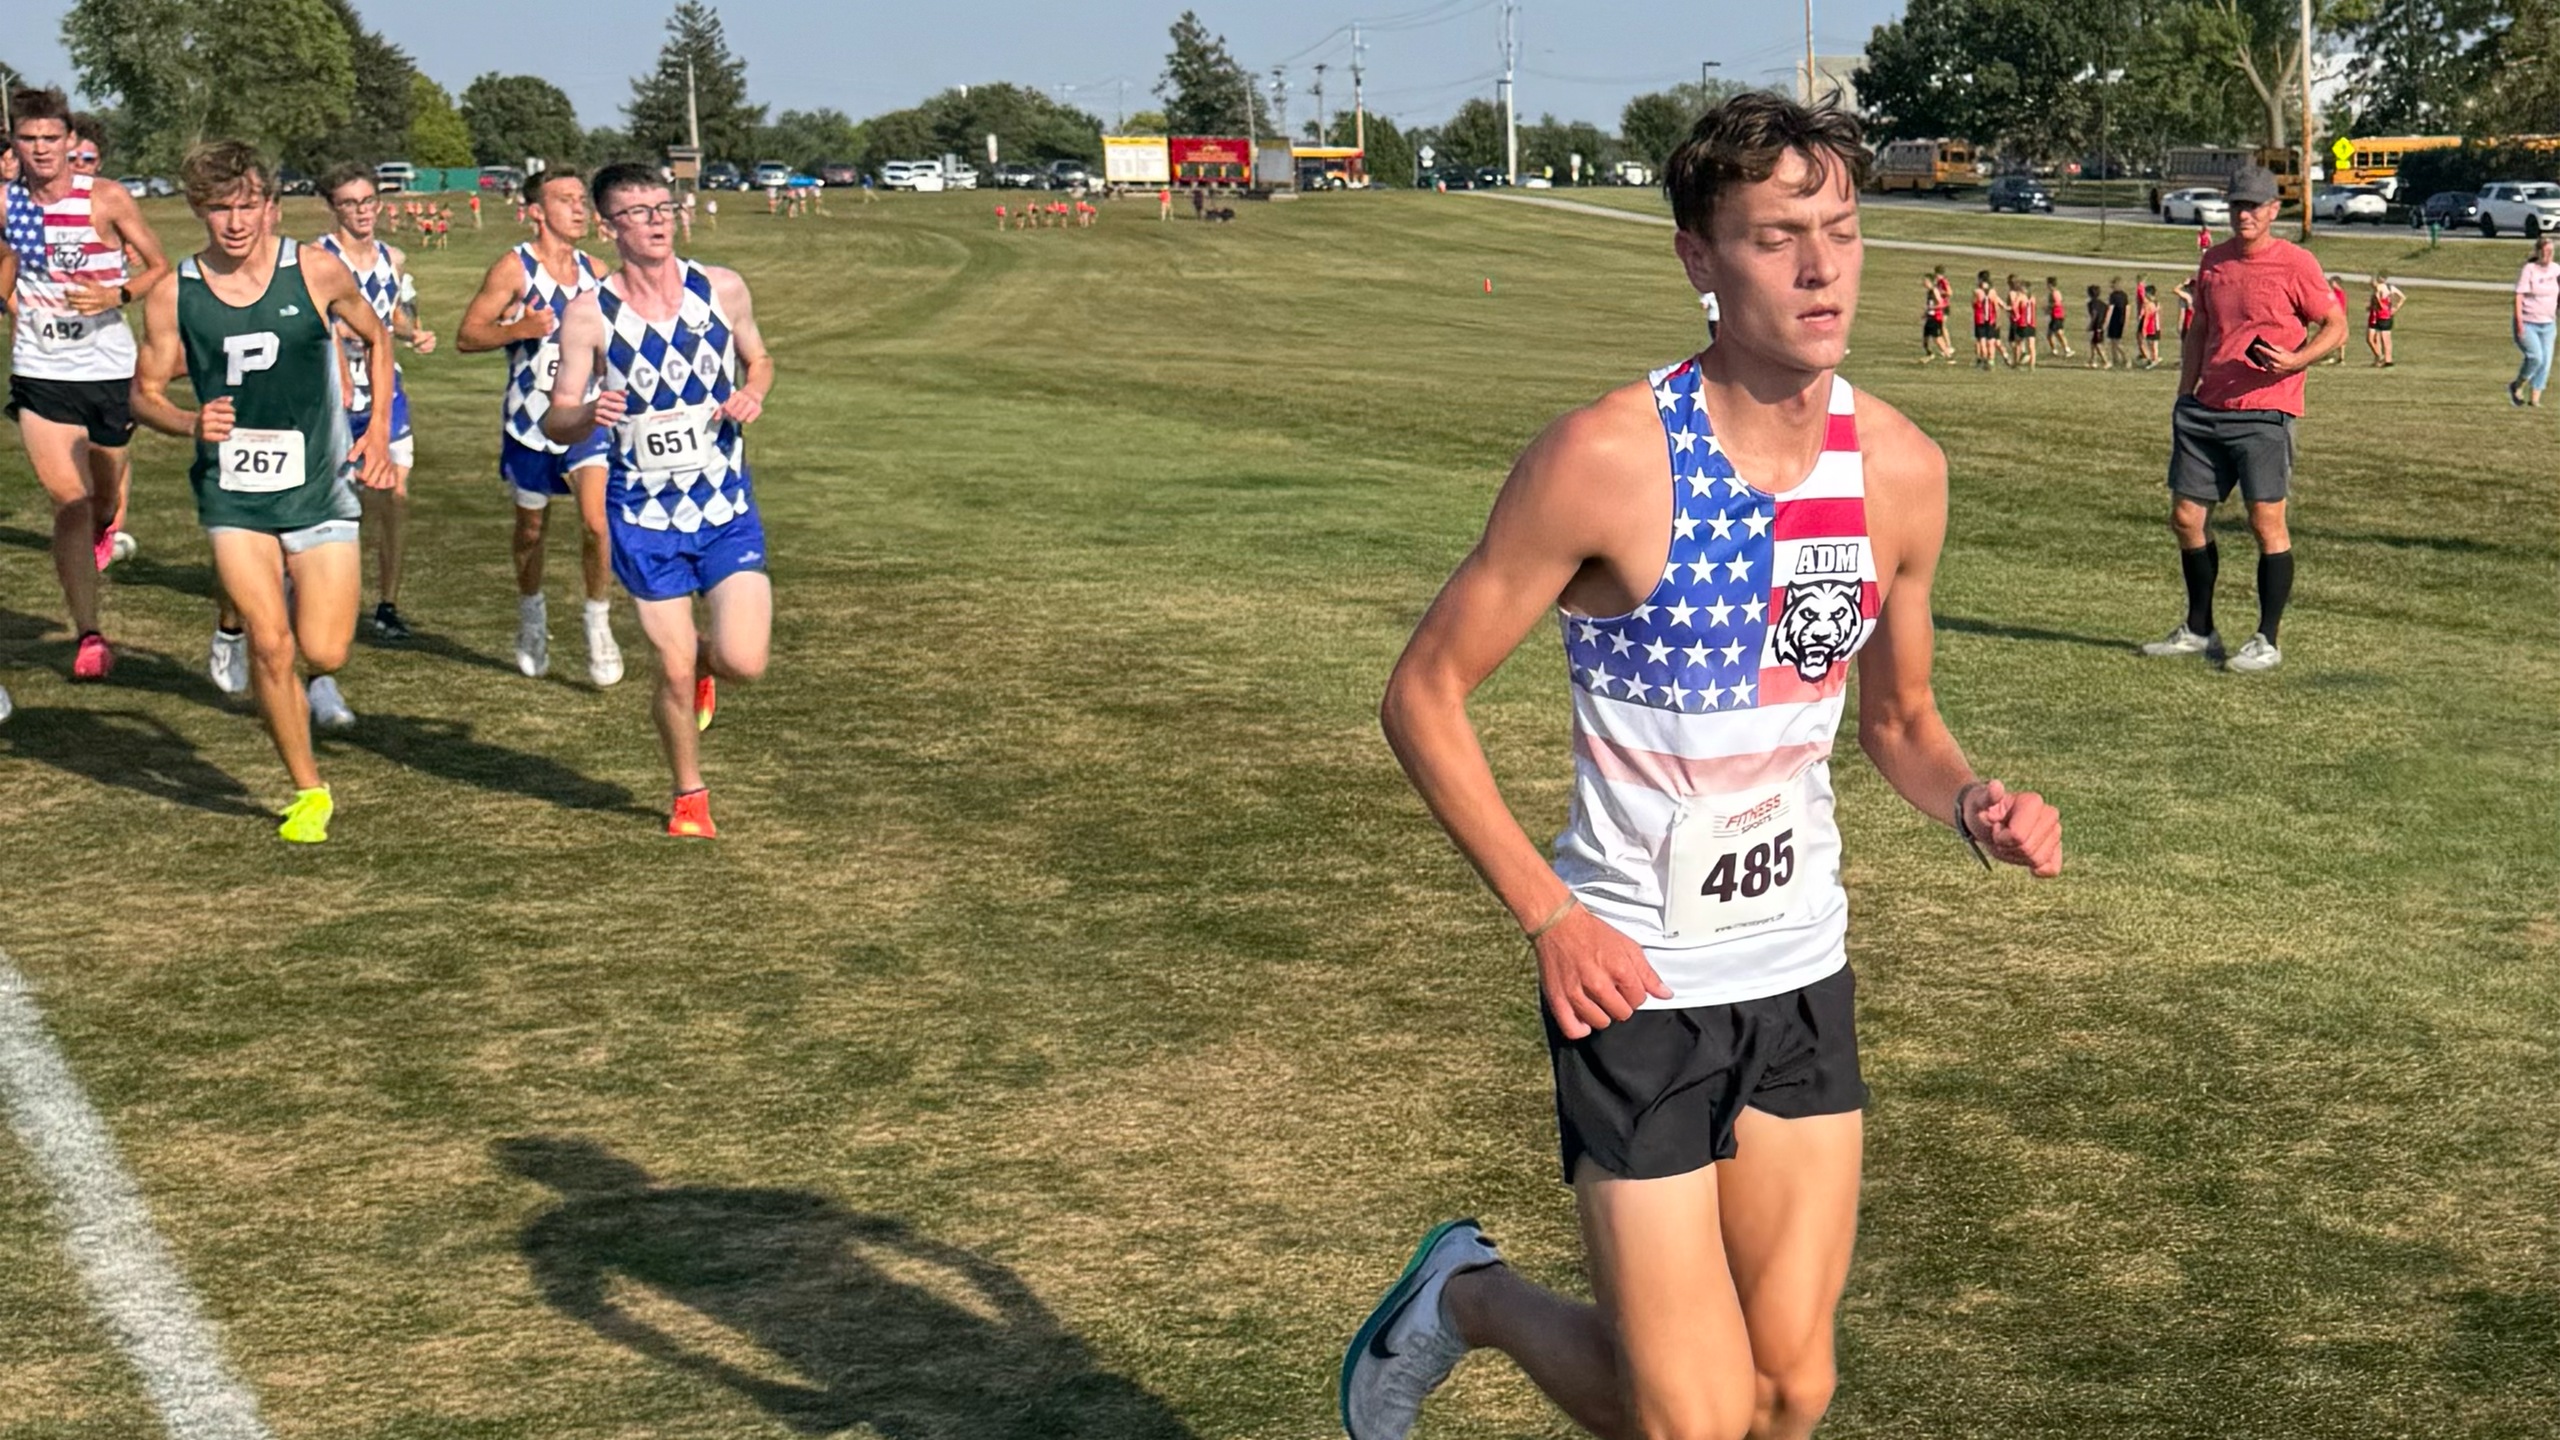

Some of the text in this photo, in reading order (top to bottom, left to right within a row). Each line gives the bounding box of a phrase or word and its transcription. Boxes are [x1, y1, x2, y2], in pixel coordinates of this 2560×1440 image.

[42, 321, 83, 340] 492
[223, 331, 280, 386] P
[635, 354, 717, 389] CCA
[646, 427, 698, 456] 651
[233, 449, 288, 474] 267
[1795, 543, 1859, 575] ADM
[1725, 793, 1781, 829] FITNESS
[1700, 828, 1795, 903] 485
